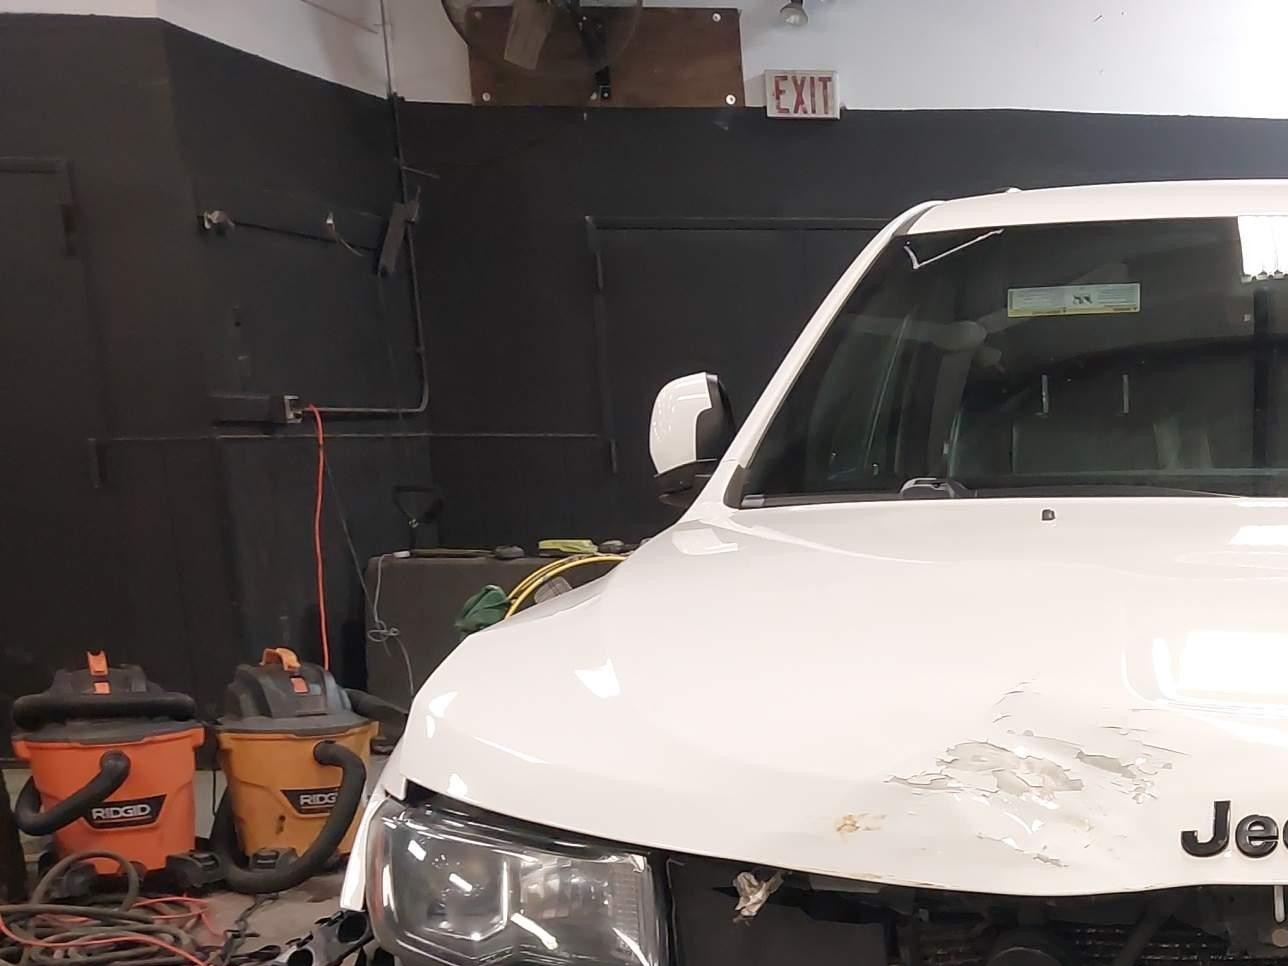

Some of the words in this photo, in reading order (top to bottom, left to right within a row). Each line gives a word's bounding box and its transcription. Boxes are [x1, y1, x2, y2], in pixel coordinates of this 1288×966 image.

[773, 75, 832, 114] EXIT
[299, 791, 338, 805] RIDG
[91, 803, 151, 820] RIDGID
